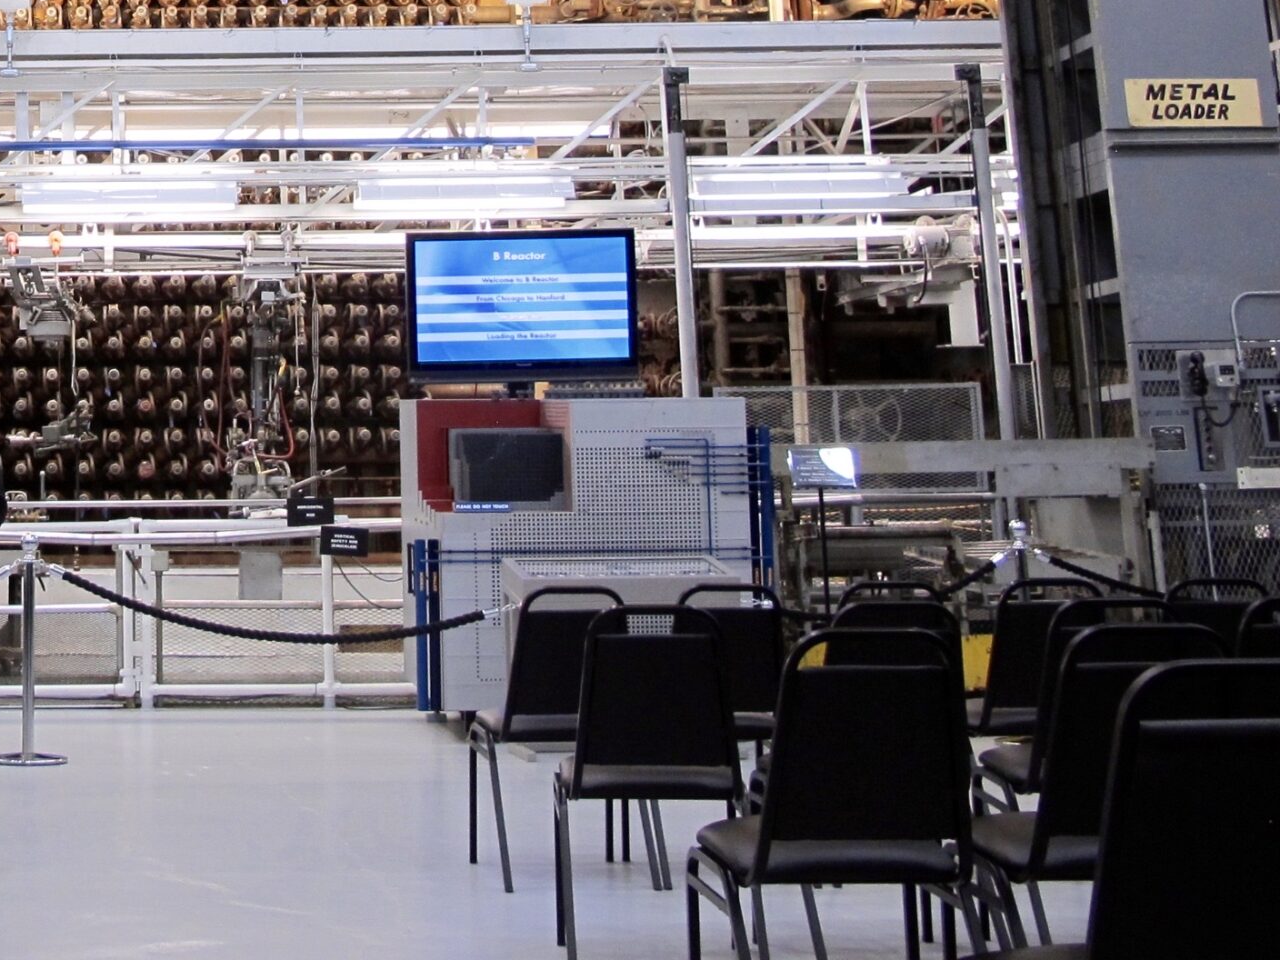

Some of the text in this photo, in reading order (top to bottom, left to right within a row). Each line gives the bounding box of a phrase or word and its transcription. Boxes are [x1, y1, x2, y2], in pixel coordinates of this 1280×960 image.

[1145, 83, 1236, 101] METAL
[1152, 104, 1229, 120] LOADER
[493, 251, 546, 261] B Reactor
[487, 333, 515, 341] Loading
